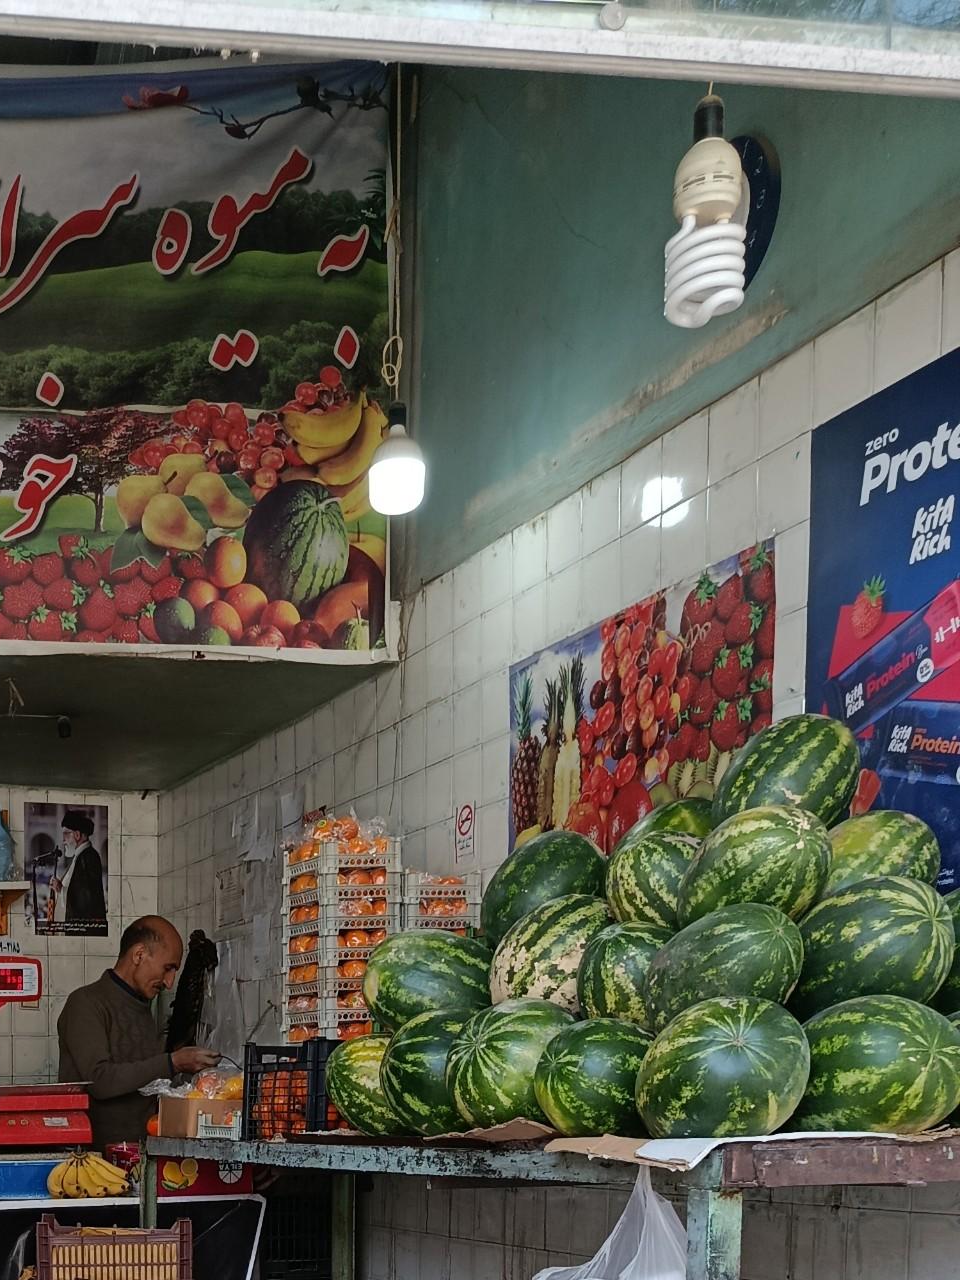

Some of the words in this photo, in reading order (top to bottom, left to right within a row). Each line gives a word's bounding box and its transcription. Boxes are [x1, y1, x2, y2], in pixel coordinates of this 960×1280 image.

[152, 145, 312, 372] میوه
[865, 427, 900, 456] zero
[909, 523, 952, 565] Rich
